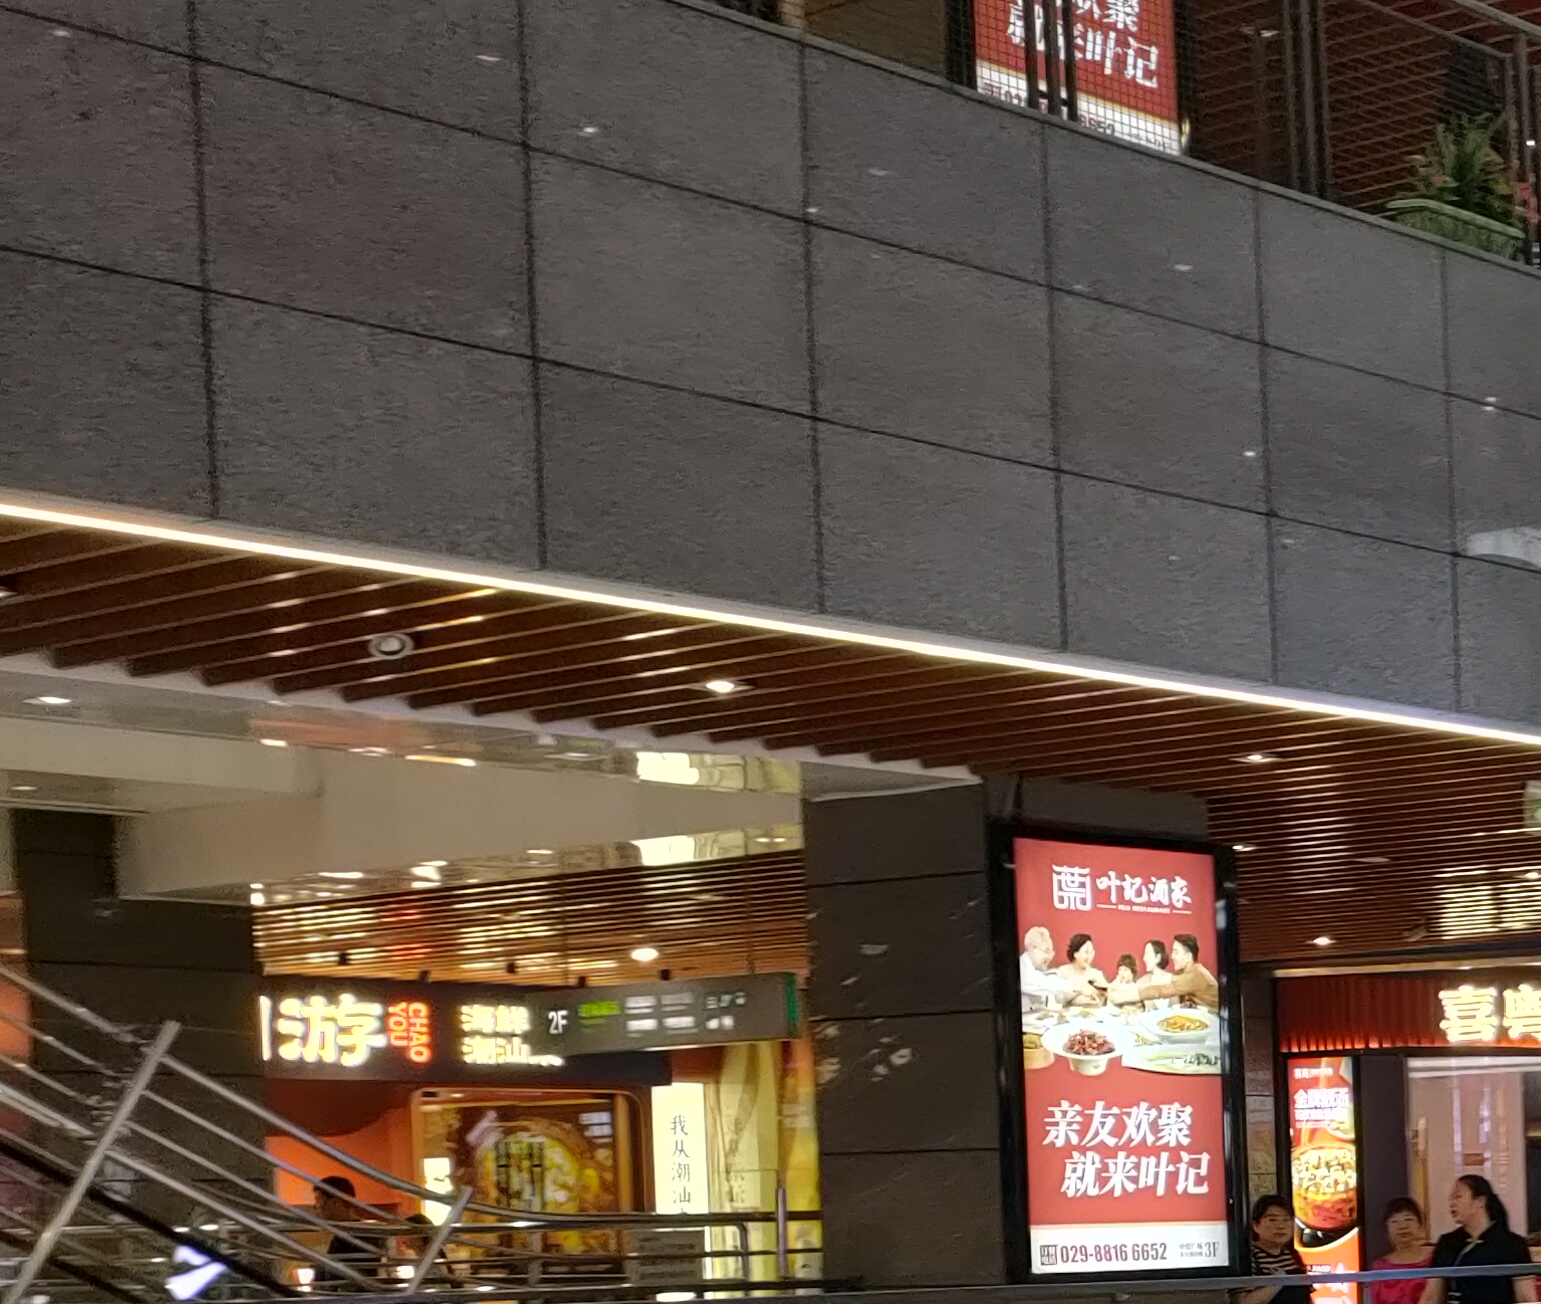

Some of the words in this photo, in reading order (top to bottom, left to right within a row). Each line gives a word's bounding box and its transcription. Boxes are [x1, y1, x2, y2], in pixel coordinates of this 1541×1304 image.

[387, 1002, 408, 1048] YOU
[406, 1001, 433, 1064] CHAO
[548, 1010, 568, 1035] 2F
[1042, 1100, 1194, 1148] 亲友欢聚
[1060, 1150, 1210, 1199] 就来叶记
[1060, 1243, 1130, 1264] 029-8816
[1132, 1242, 1167, 1261] 6652
